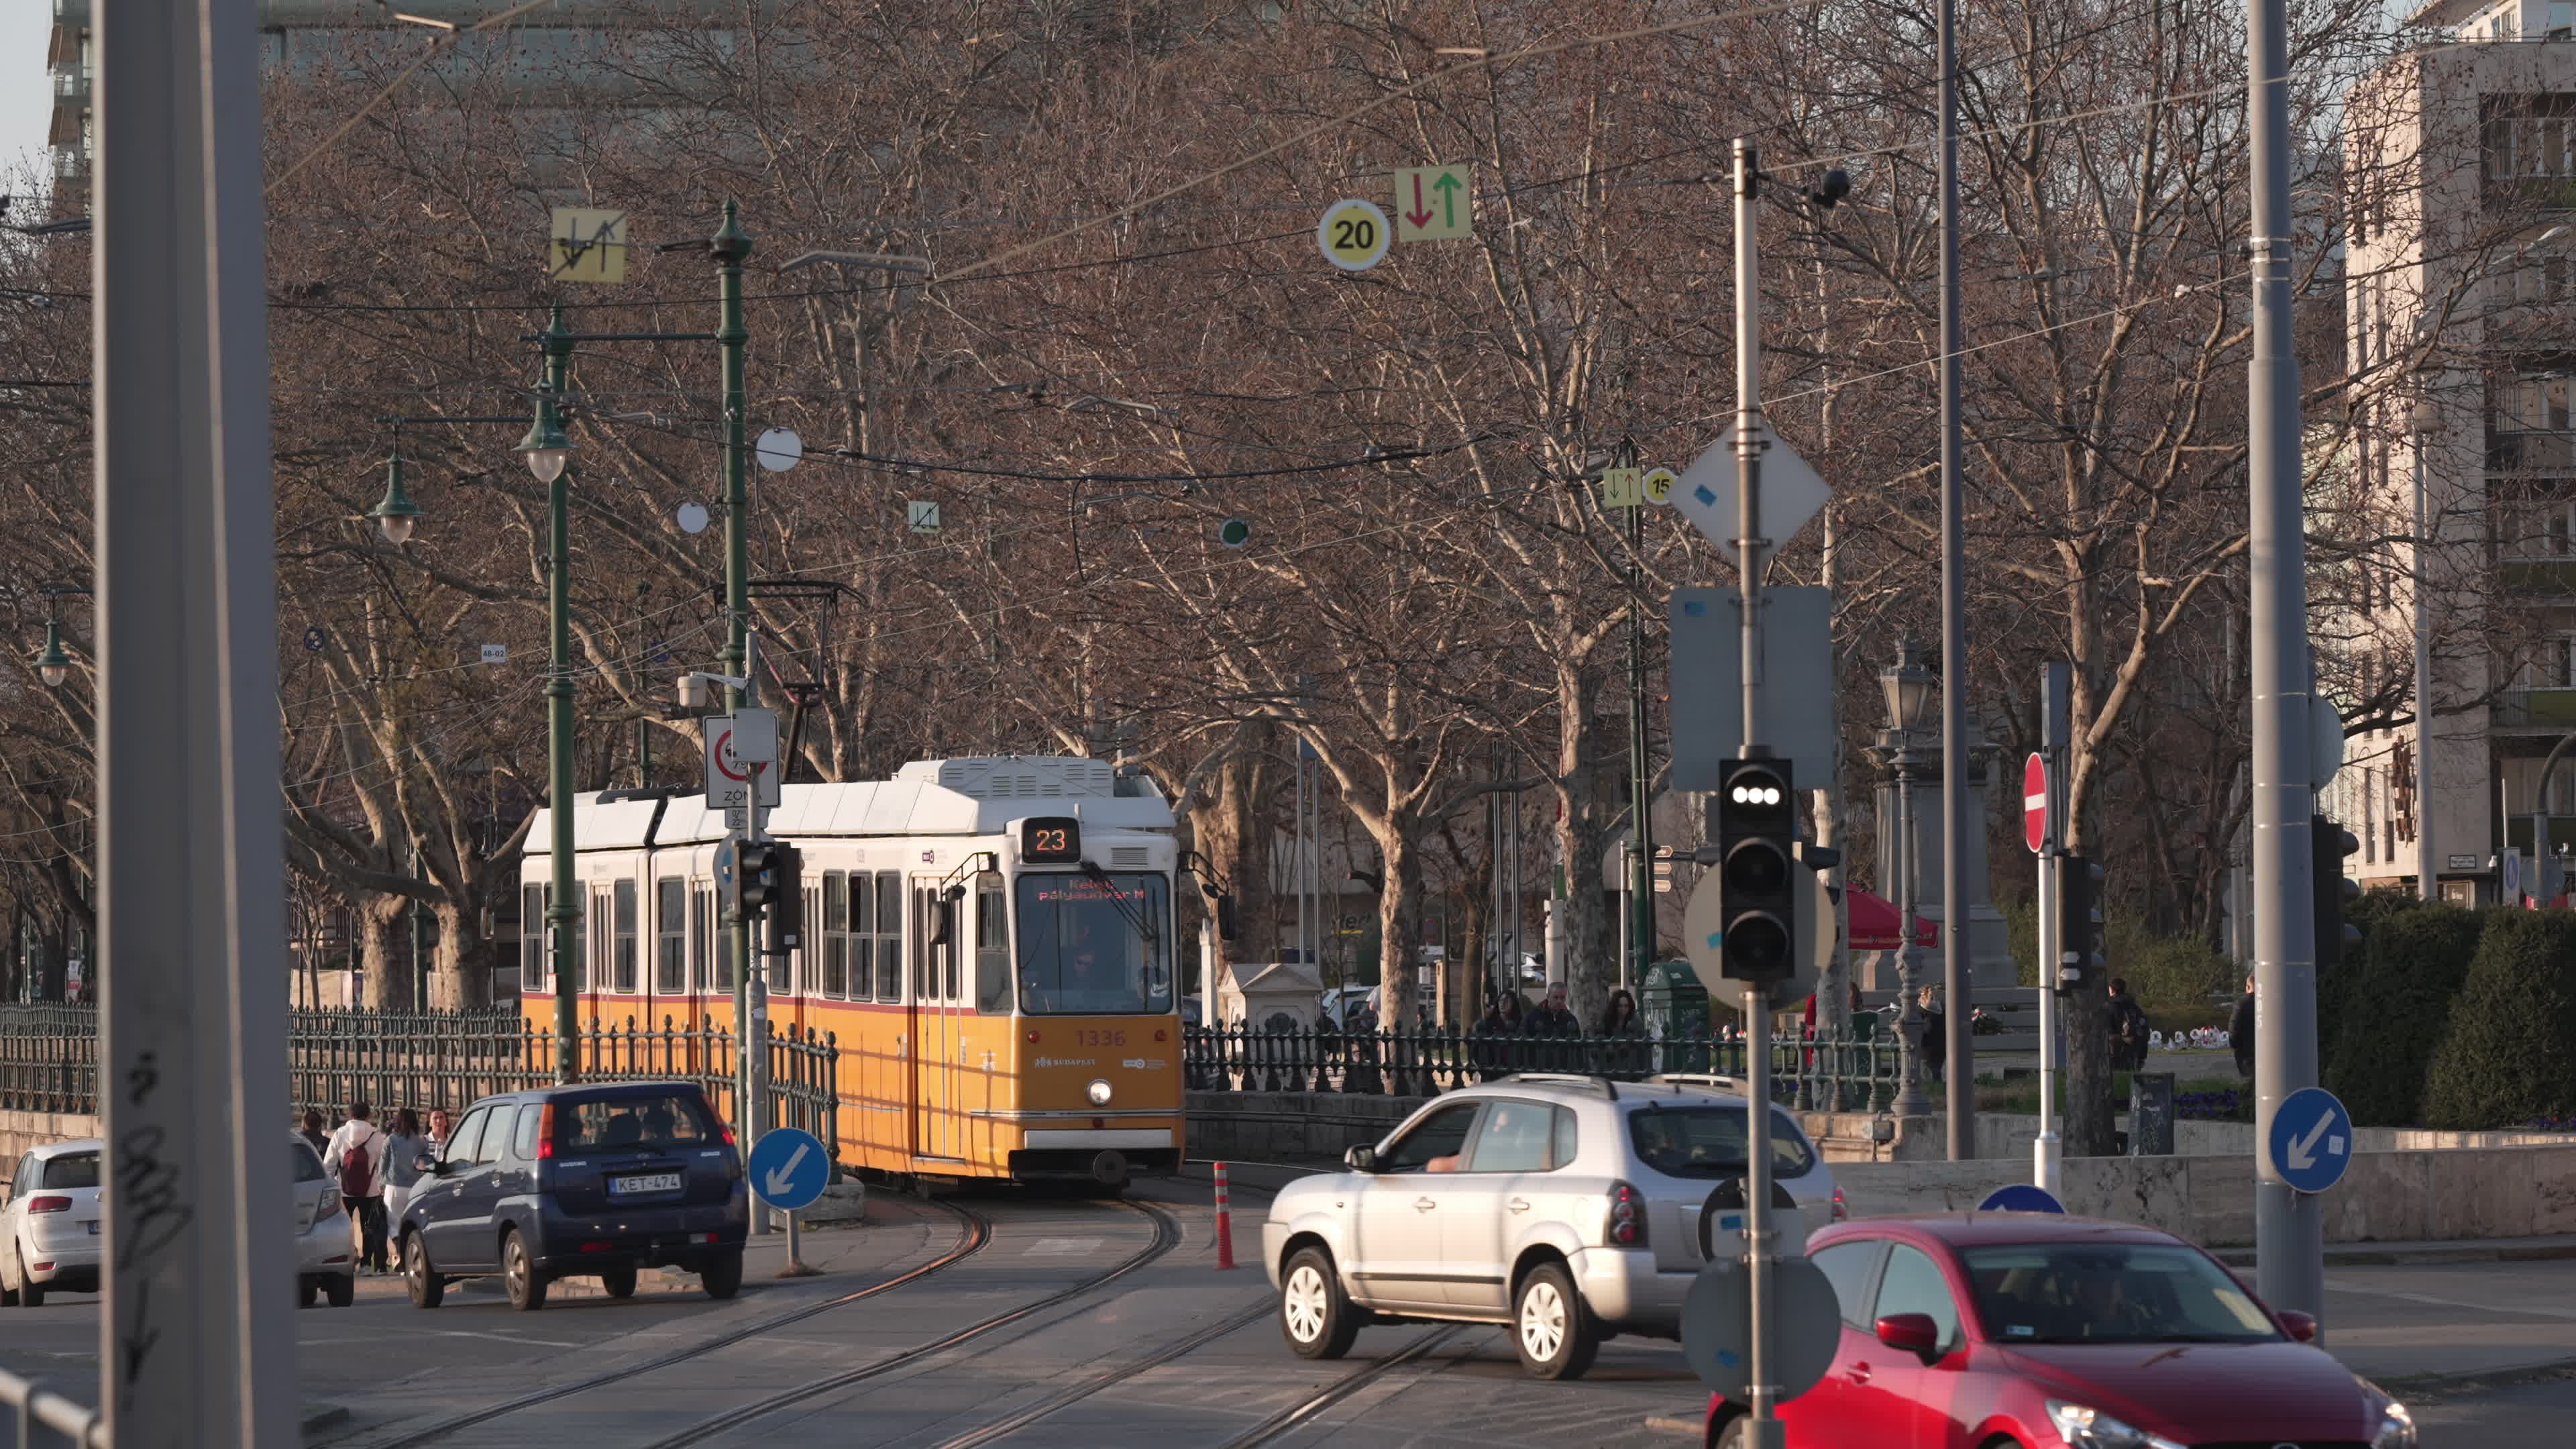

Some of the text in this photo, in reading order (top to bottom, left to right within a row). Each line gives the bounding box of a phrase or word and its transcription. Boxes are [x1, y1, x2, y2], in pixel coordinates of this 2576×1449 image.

[1334, 220, 1373, 249] 20
[1652, 478, 1670, 494] 15
[1036, 828, 1067, 851] 23
[1075, 1030, 1127, 1047] 1336
